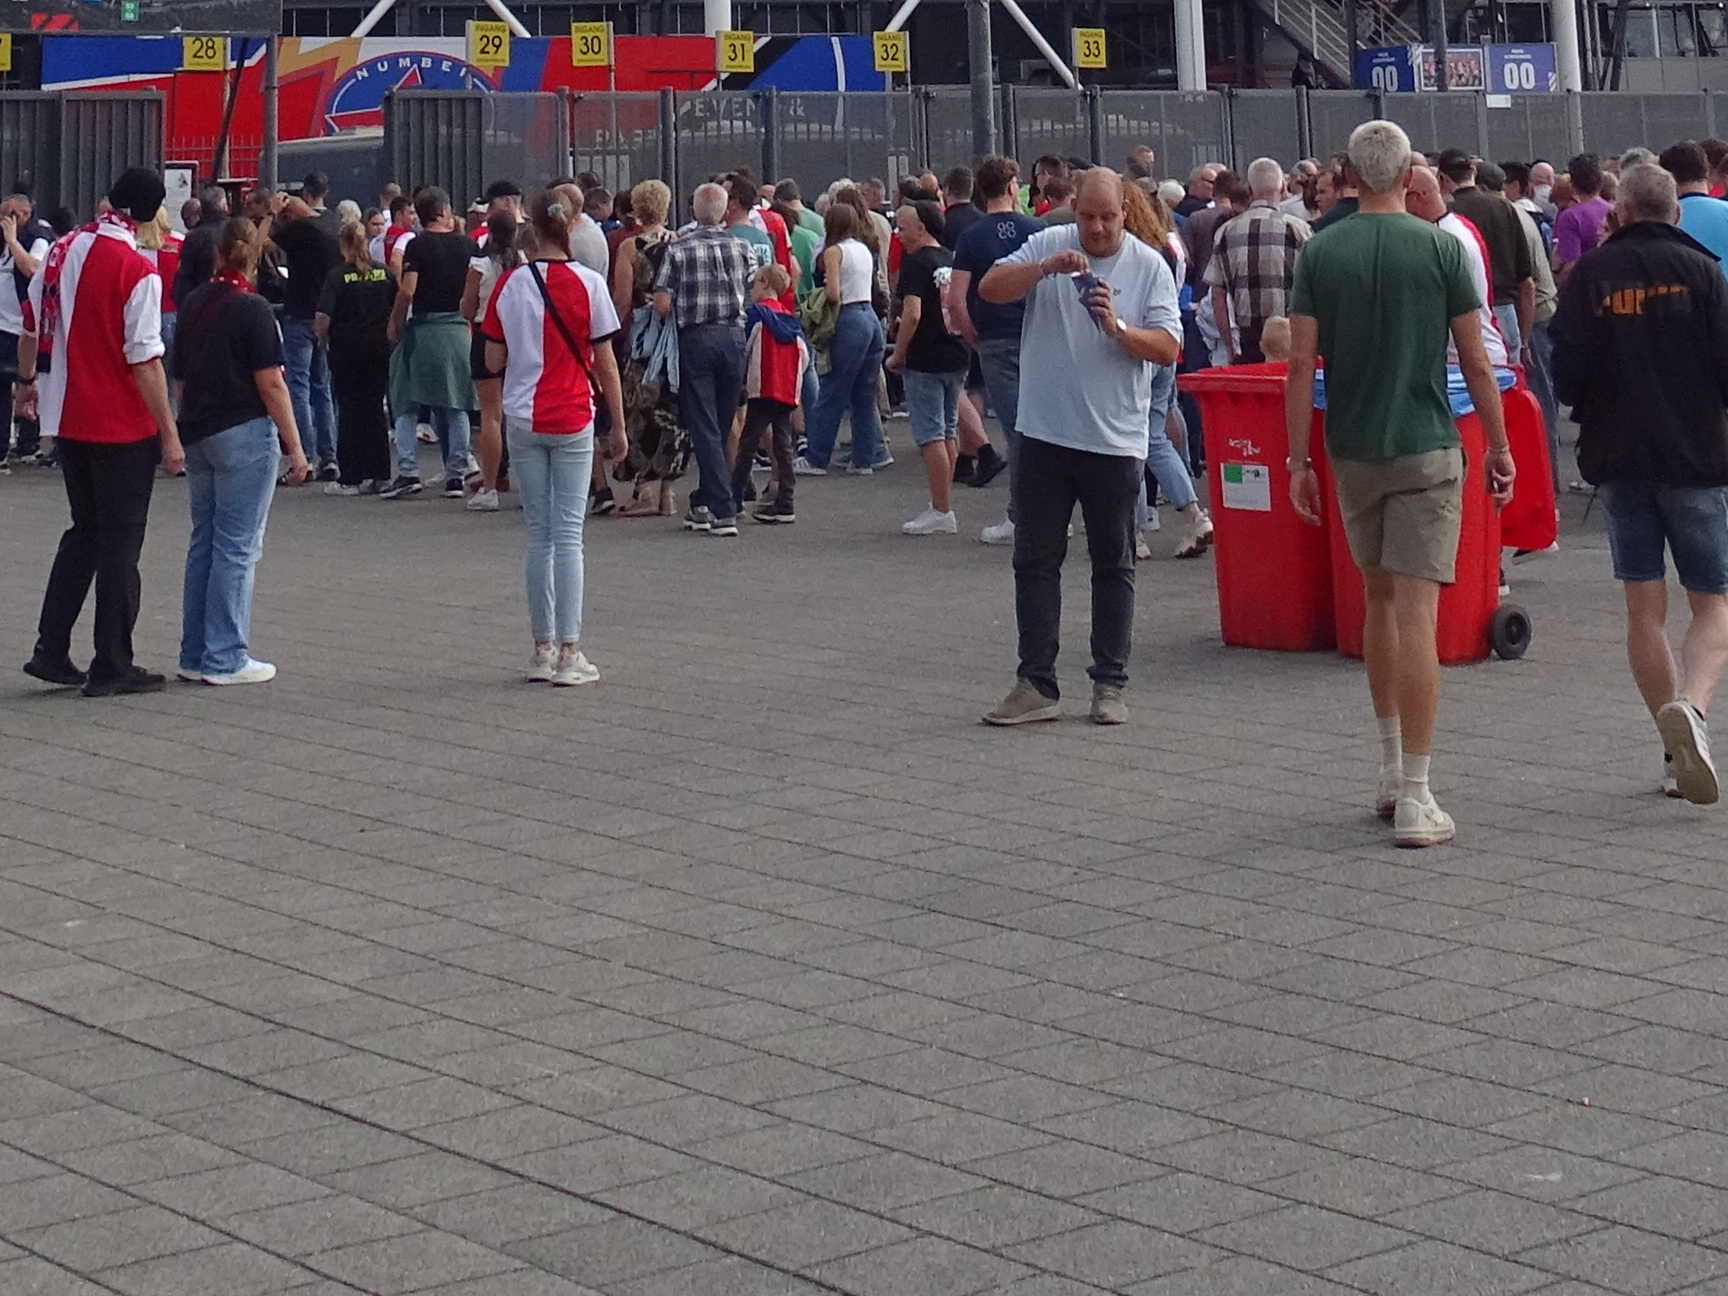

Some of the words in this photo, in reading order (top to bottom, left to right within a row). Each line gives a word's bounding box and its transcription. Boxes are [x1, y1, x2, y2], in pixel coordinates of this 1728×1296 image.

[475, 23, 507, 33] INGANG
[575, 24, 605, 33] INGANG
[191, 38, 216, 59] 28
[479, 34, 503, 55] 29
[579, 35, 602, 55] 30
[728, 43, 746, 61] 31
[880, 43, 899, 61] 32
[1083, 40, 1101, 58] 33
